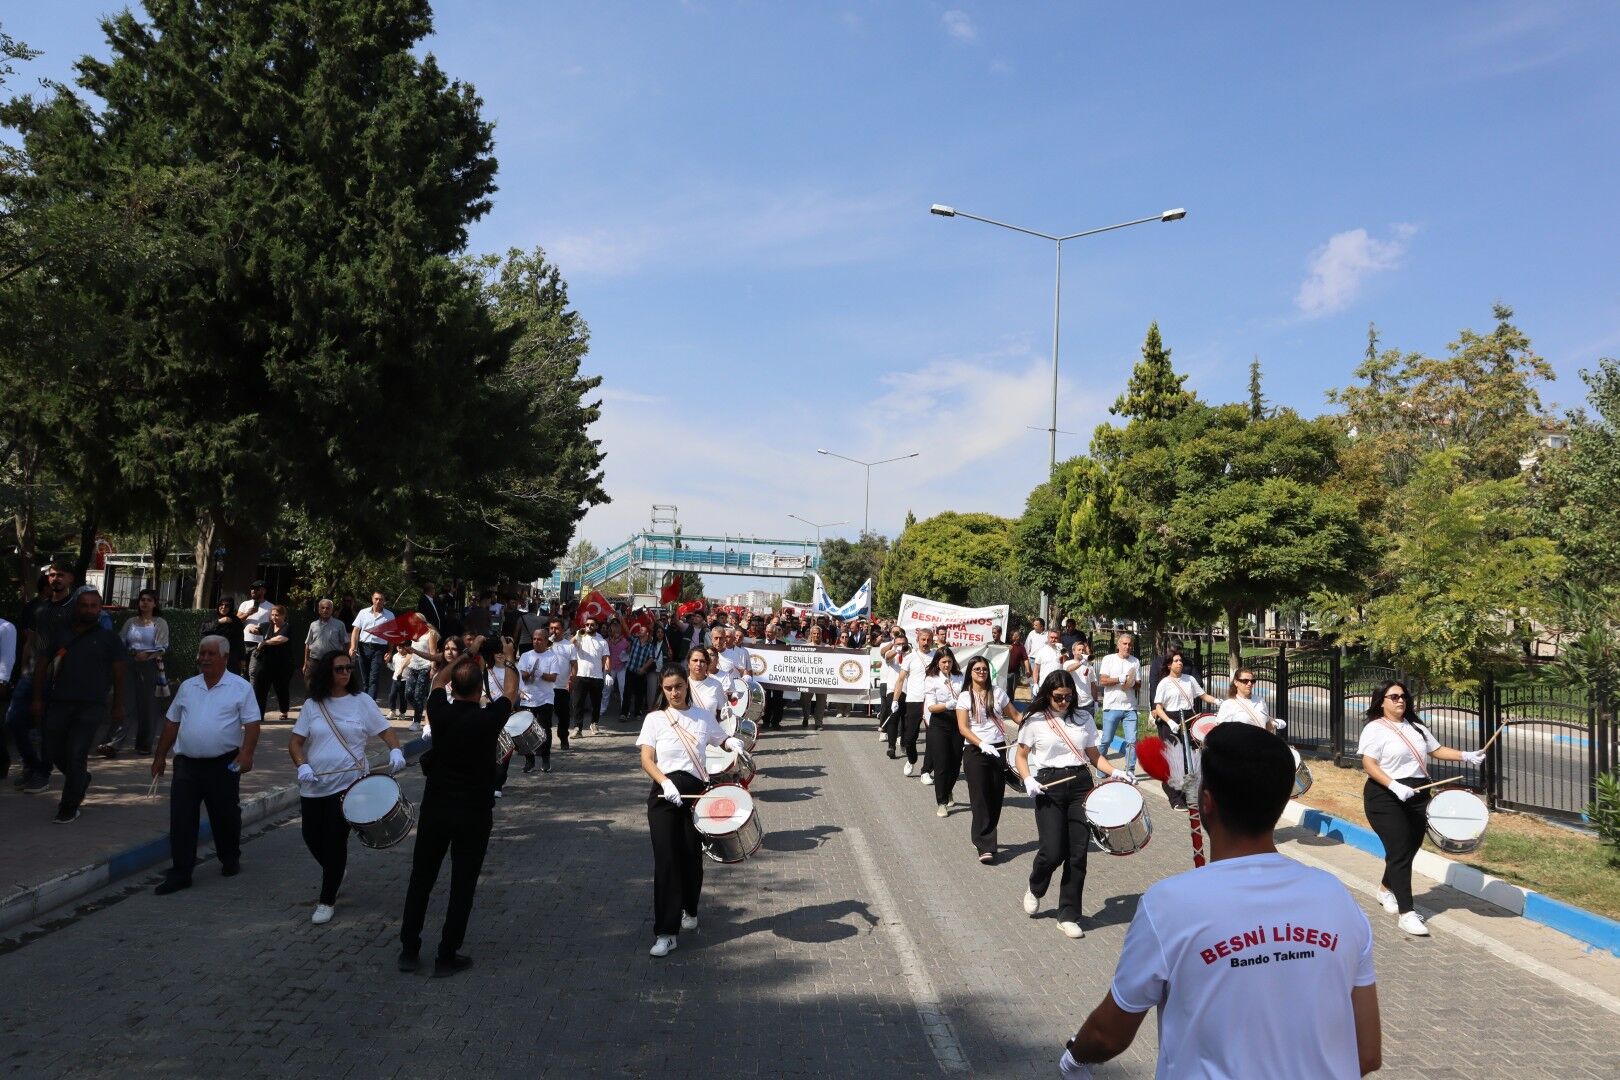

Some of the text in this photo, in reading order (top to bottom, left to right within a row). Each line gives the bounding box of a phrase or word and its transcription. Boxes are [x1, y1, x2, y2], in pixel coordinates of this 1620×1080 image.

[953, 632, 984, 642] SİTESİ
[783, 655, 823, 665] BESNİLİLER
[773, 664, 796, 673] EĞİTİM
[797, 666, 825, 675] KÜLTÜR
[825, 667, 835, 676] VE
[768, 674, 839, 686] DAYANIŞMA DERNEĞİ
[1200, 923, 1338, 965] BESNİ LİSESİ
[1230, 950, 1315, 968] Bando Takımı
